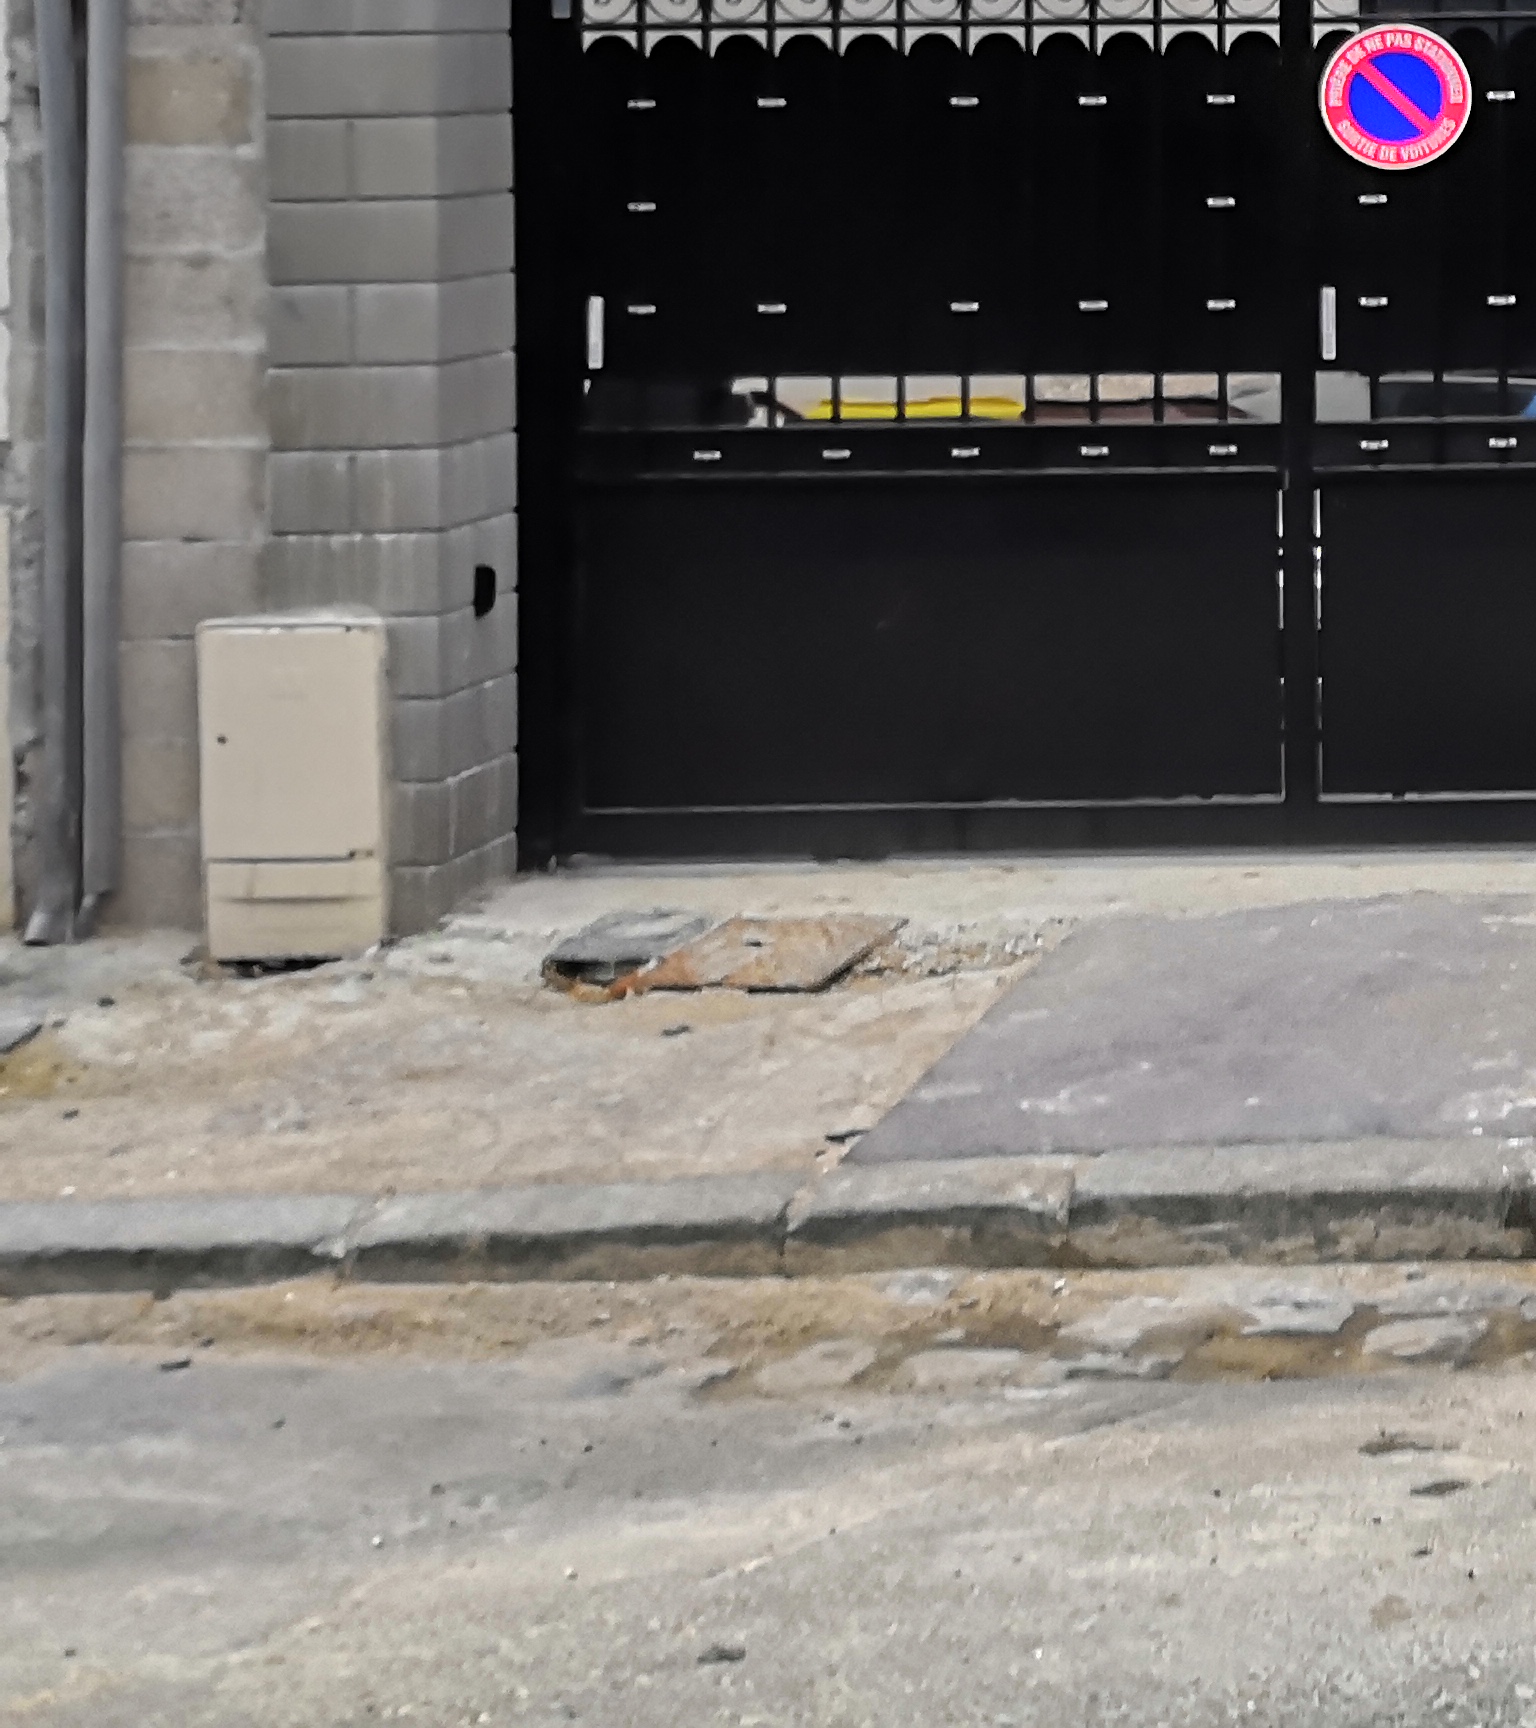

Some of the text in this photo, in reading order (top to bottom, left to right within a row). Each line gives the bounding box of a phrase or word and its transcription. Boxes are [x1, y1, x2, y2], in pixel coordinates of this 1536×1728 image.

[1384, 32, 1412, 49] PAS
[1336, 117, 1456, 161] STIE DE VOITES
